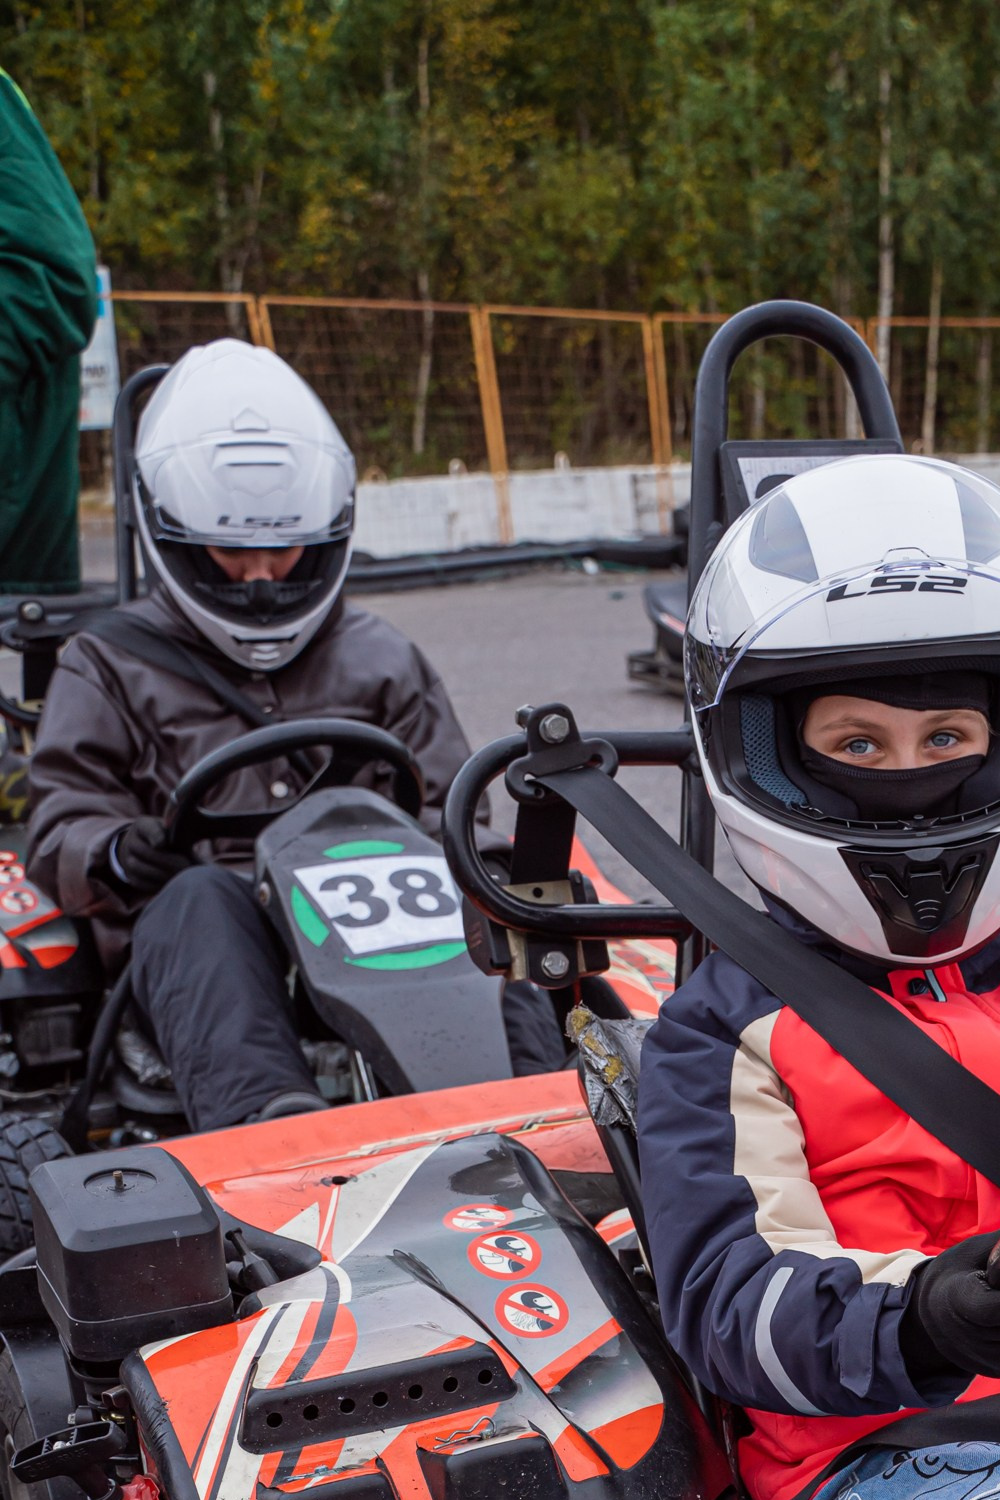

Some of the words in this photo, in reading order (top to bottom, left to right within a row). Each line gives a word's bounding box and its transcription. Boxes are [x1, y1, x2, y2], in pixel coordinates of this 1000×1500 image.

[217, 515, 302, 529] LS2
[825, 574, 968, 602] LS2
[319, 868, 457, 928] 38
